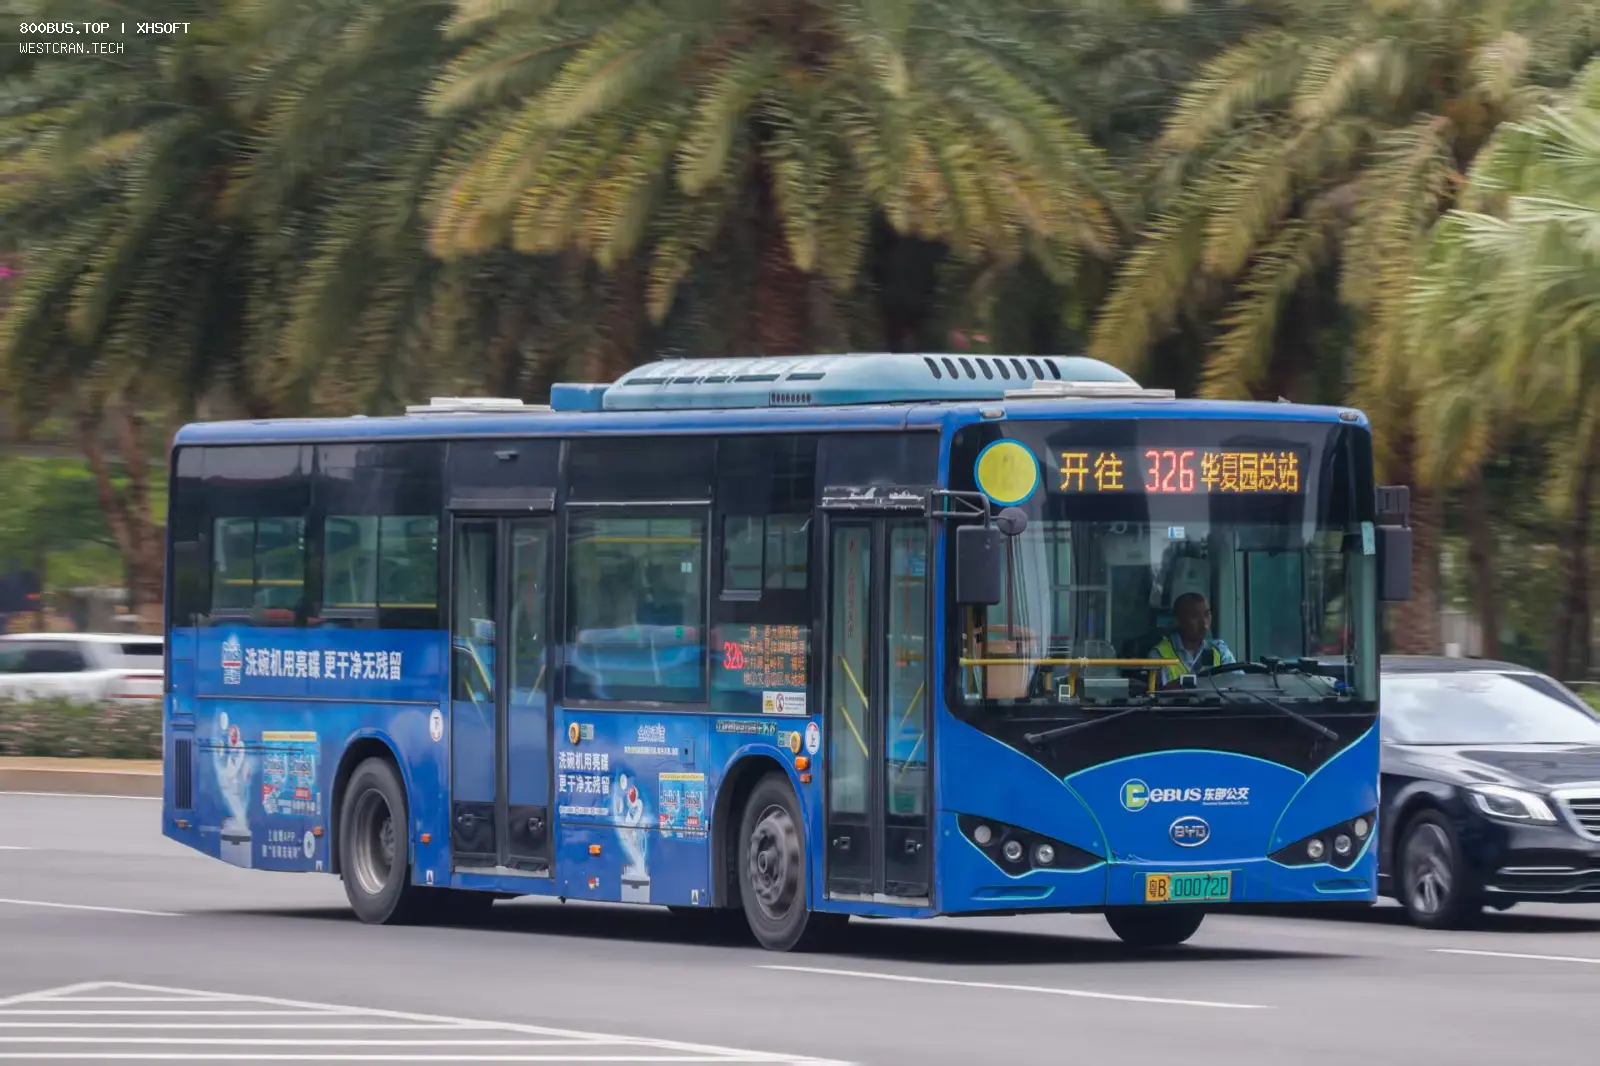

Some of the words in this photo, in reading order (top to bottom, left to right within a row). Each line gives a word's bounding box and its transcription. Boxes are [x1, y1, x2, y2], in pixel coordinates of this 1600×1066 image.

[1060, 452, 1124, 491] 开往
[1145, 450, 1194, 492] 326
[1200, 451, 1298, 492] 华夏园总站
[324, 650, 402, 681] 更干净无残留
[558, 774, 610, 795] 更干净无残留
[1203, 787, 1250, 801] 东部公交
[1174, 825, 1206, 838] BYD
